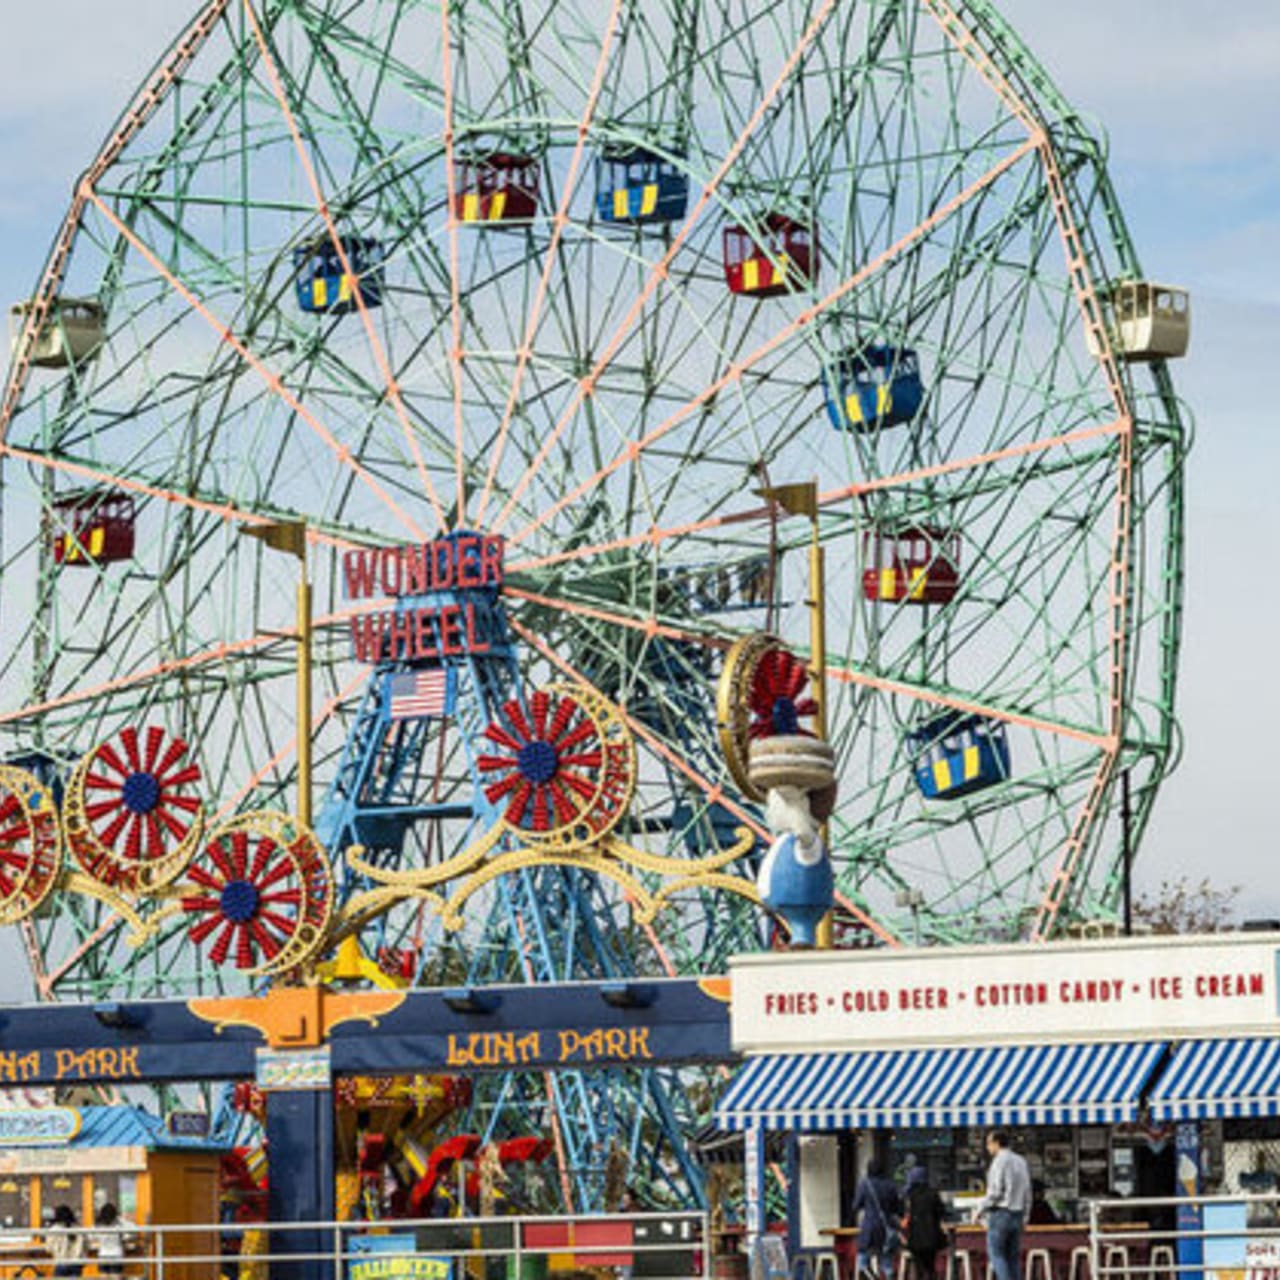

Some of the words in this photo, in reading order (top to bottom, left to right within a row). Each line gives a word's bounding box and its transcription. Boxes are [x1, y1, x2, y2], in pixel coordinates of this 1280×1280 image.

[343, 534, 505, 600] WONDER
[350, 603, 490, 665] WHEEL
[764, 993, 818, 1015] FRIES
[842, 990, 889, 1012] COLD
[898, 987, 948, 1010] BEER
[974, 983, 1047, 1006] COTTON
[1059, 980, 1124, 1003] CANDY
[1150, 977, 1180, 1000] ICE
[1195, 974, 1264, 998] CREAM
[55, 1047, 141, 1079] PARK
[447, 1033, 540, 1065] LUNA
[558, 1027, 652, 1062] PARK
